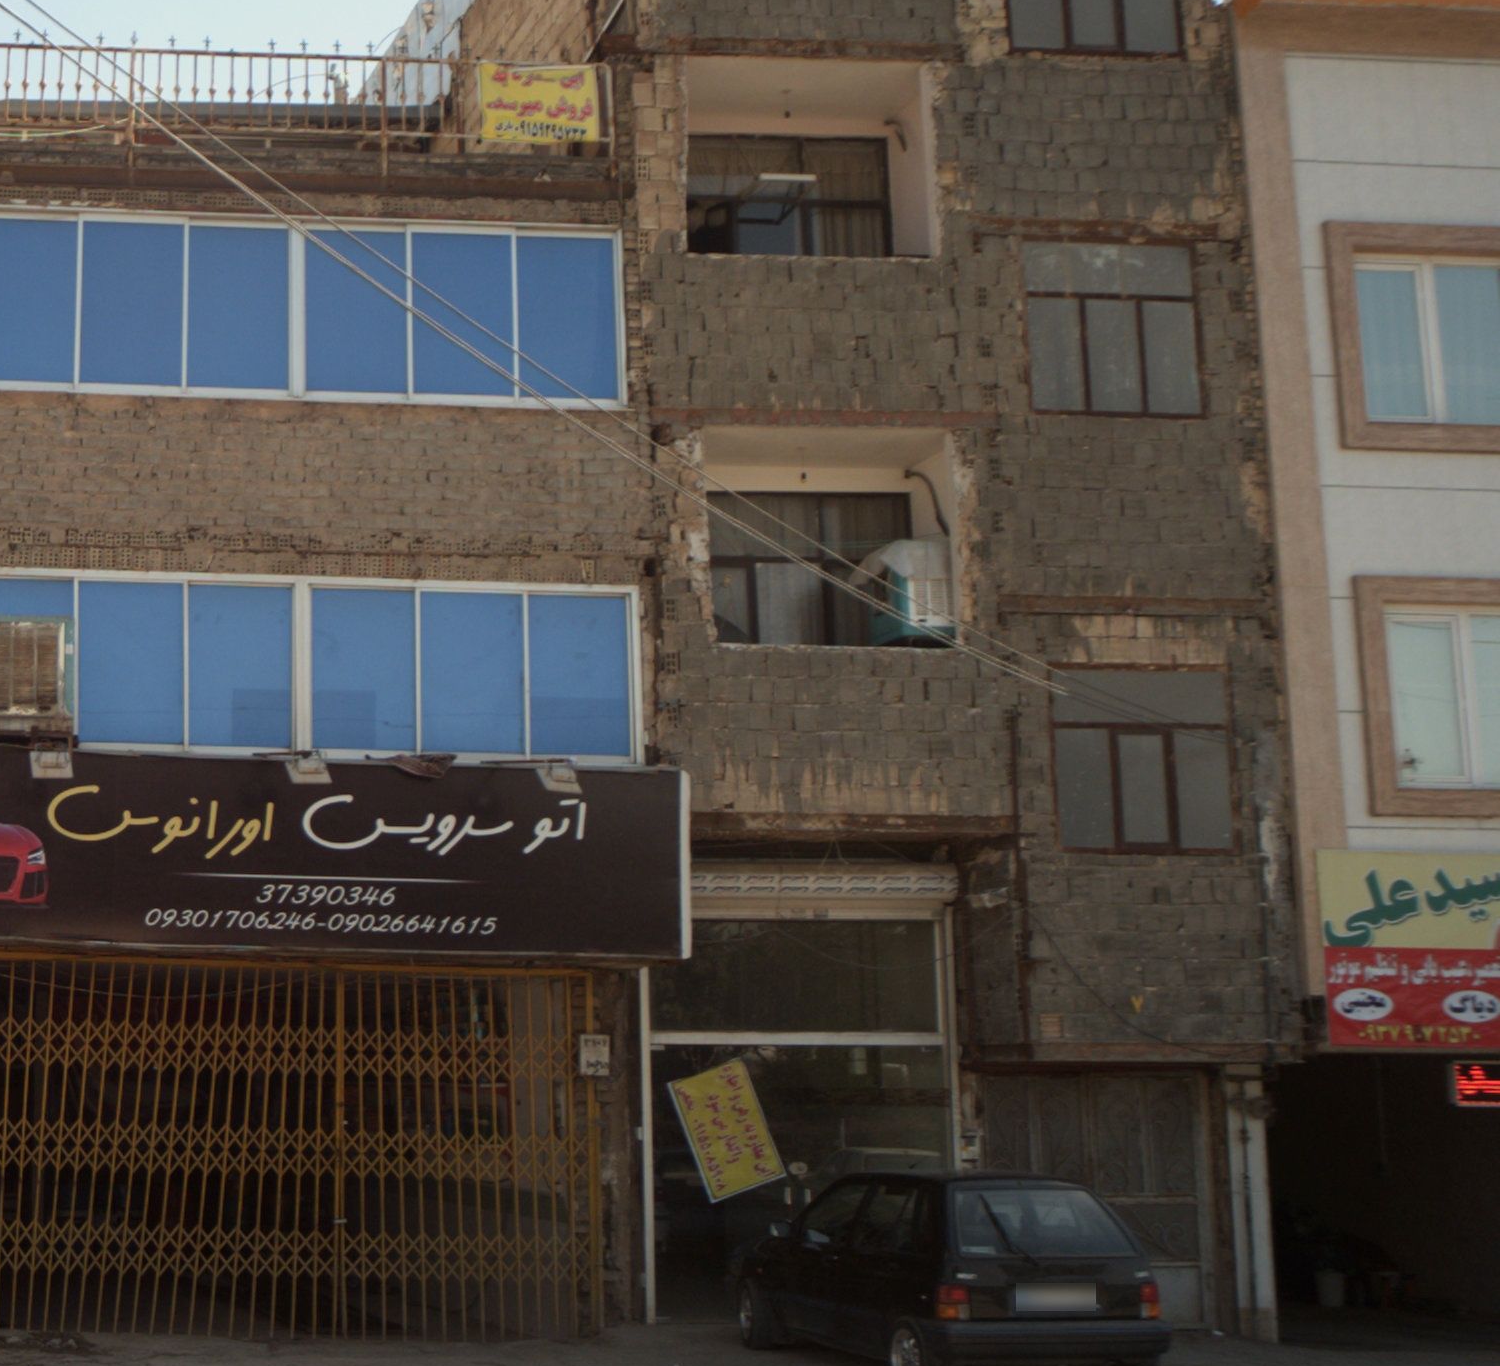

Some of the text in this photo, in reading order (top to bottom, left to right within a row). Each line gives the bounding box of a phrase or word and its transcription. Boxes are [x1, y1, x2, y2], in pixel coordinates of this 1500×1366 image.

[46, 784, 587, 859] اتو سرویس اورانوس
[255, 883, 396, 906] 37390346
[144, 907, 498, 936] 09301706246-09026641615
